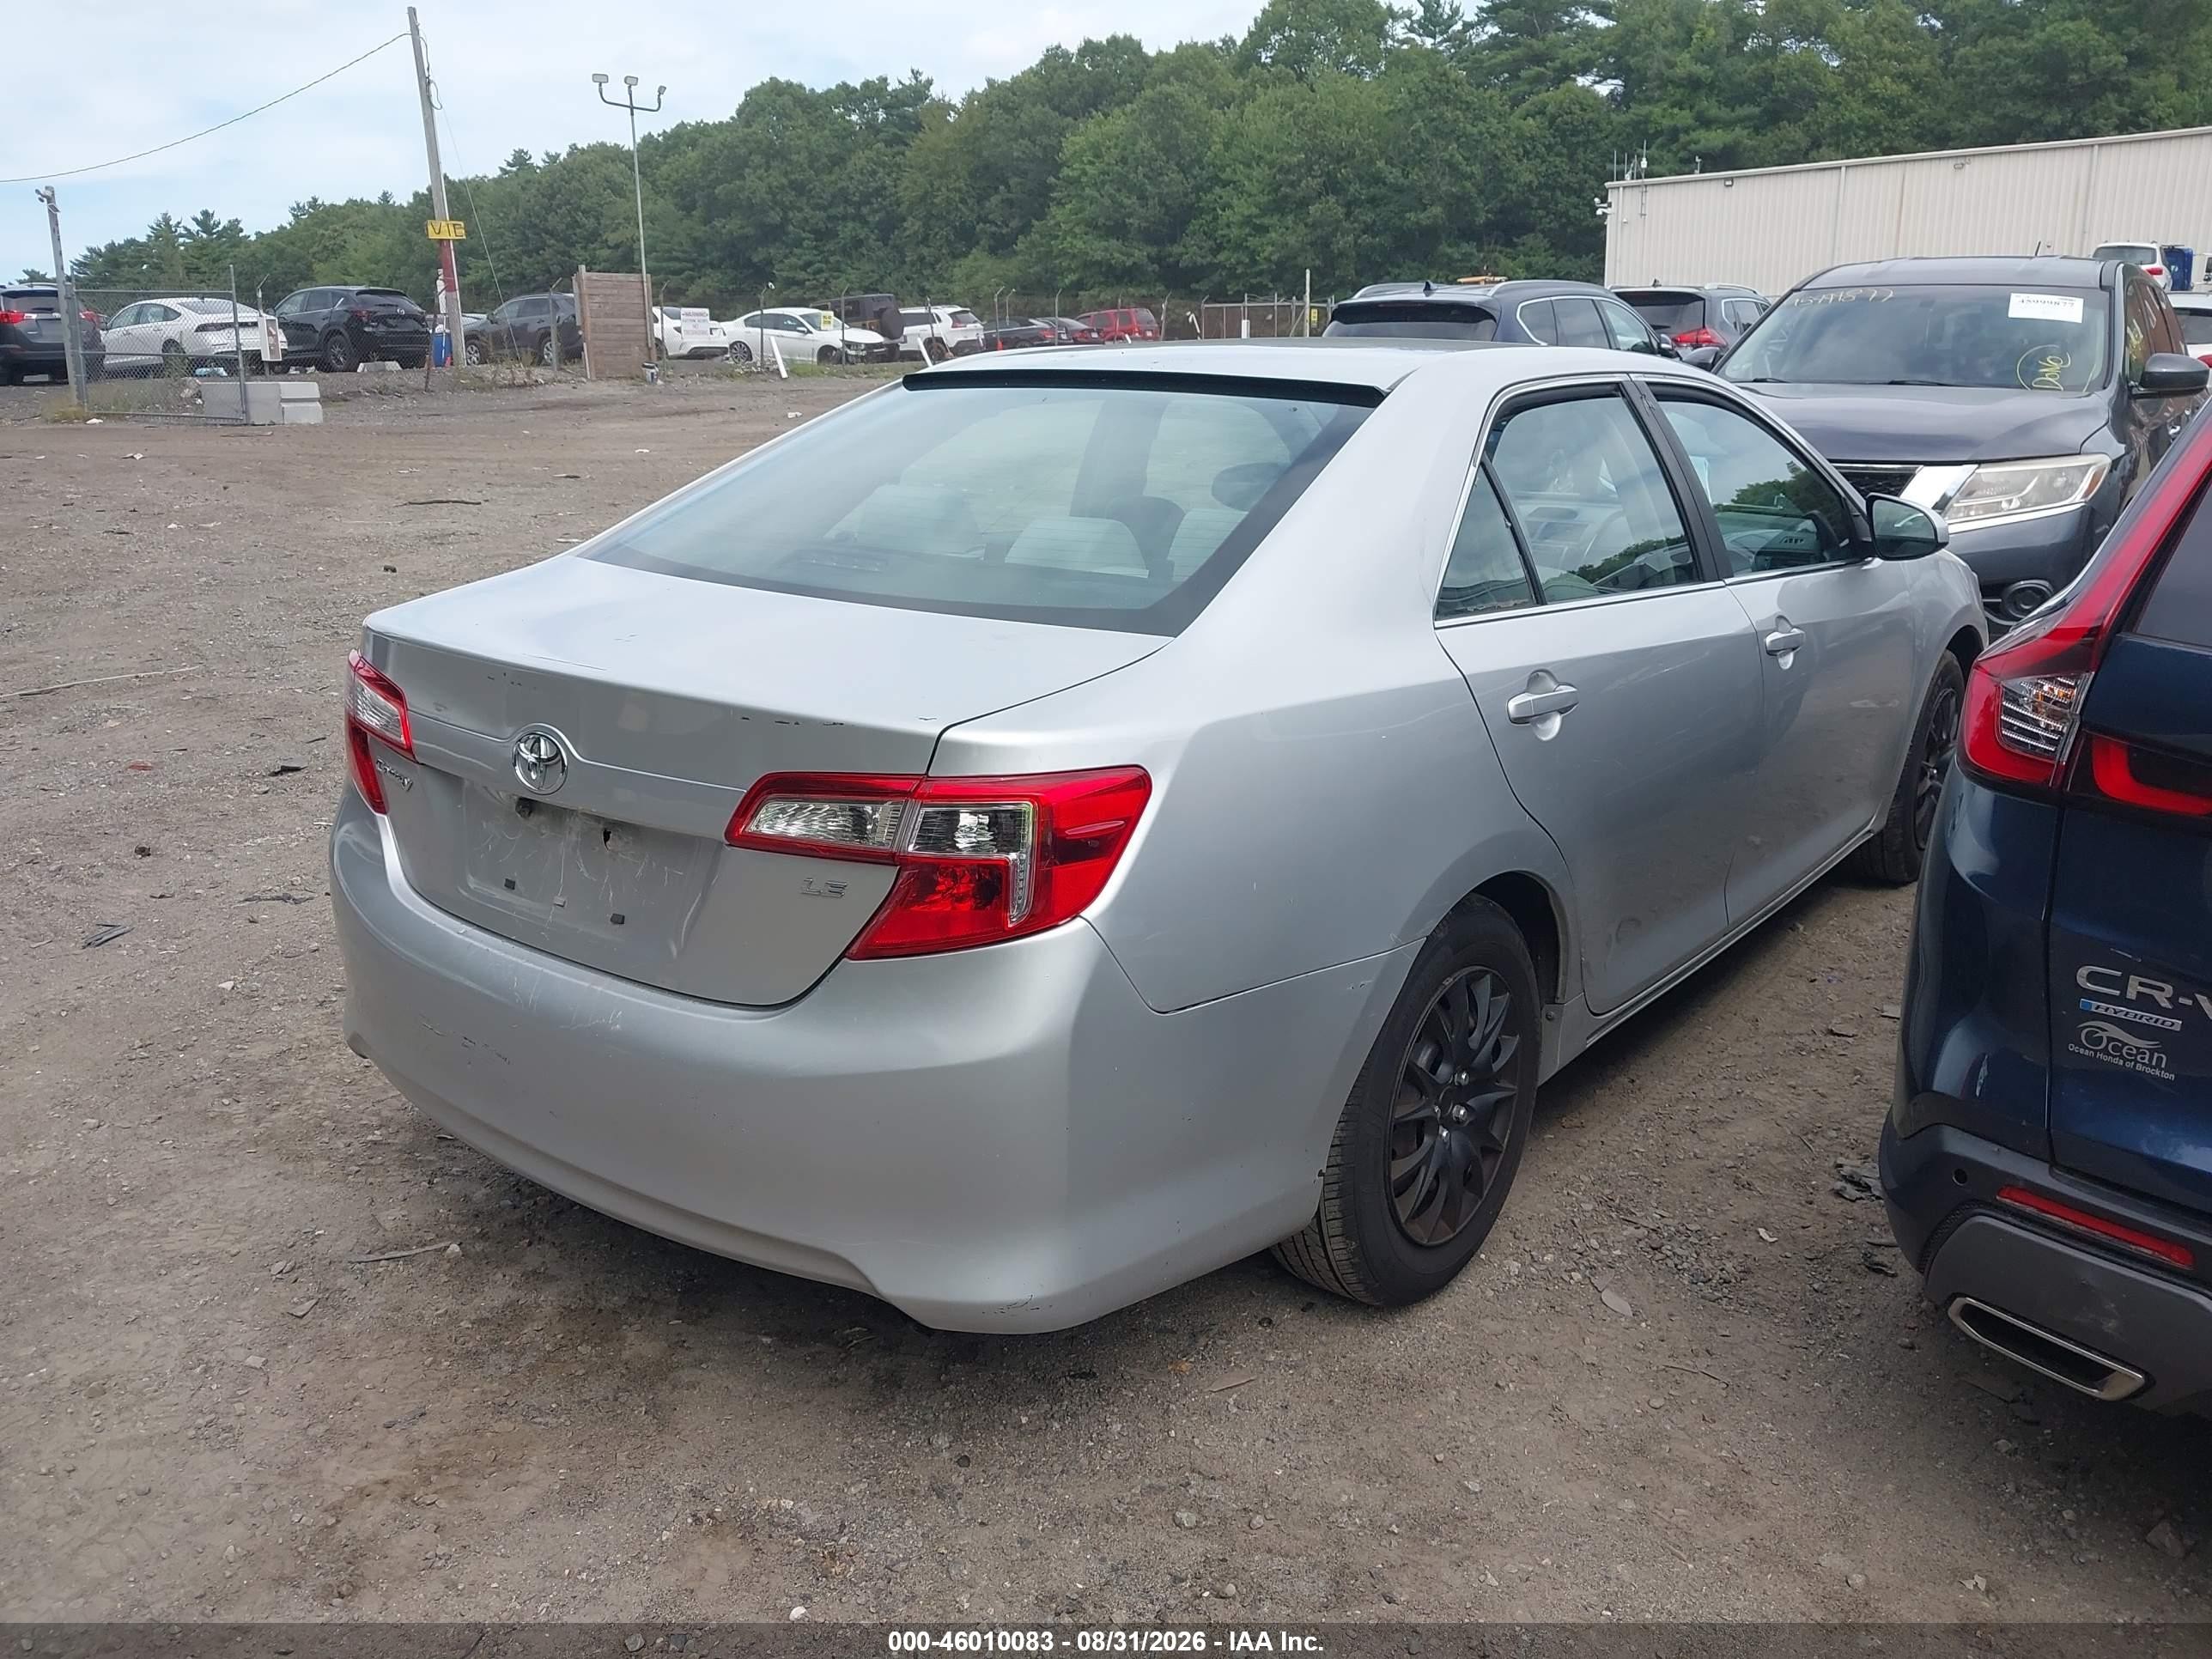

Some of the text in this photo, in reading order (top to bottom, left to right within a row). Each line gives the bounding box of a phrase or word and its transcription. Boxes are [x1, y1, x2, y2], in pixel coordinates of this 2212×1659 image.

[2094, 1005, 2176, 1028] HYBRID
[2068, 1043, 2094, 1057] Ocean
[2096, 1052, 2124, 1066] Honda
[2136, 1063, 2175, 1081] Brockton
[2081, 1027, 2167, 1068] Ocean
